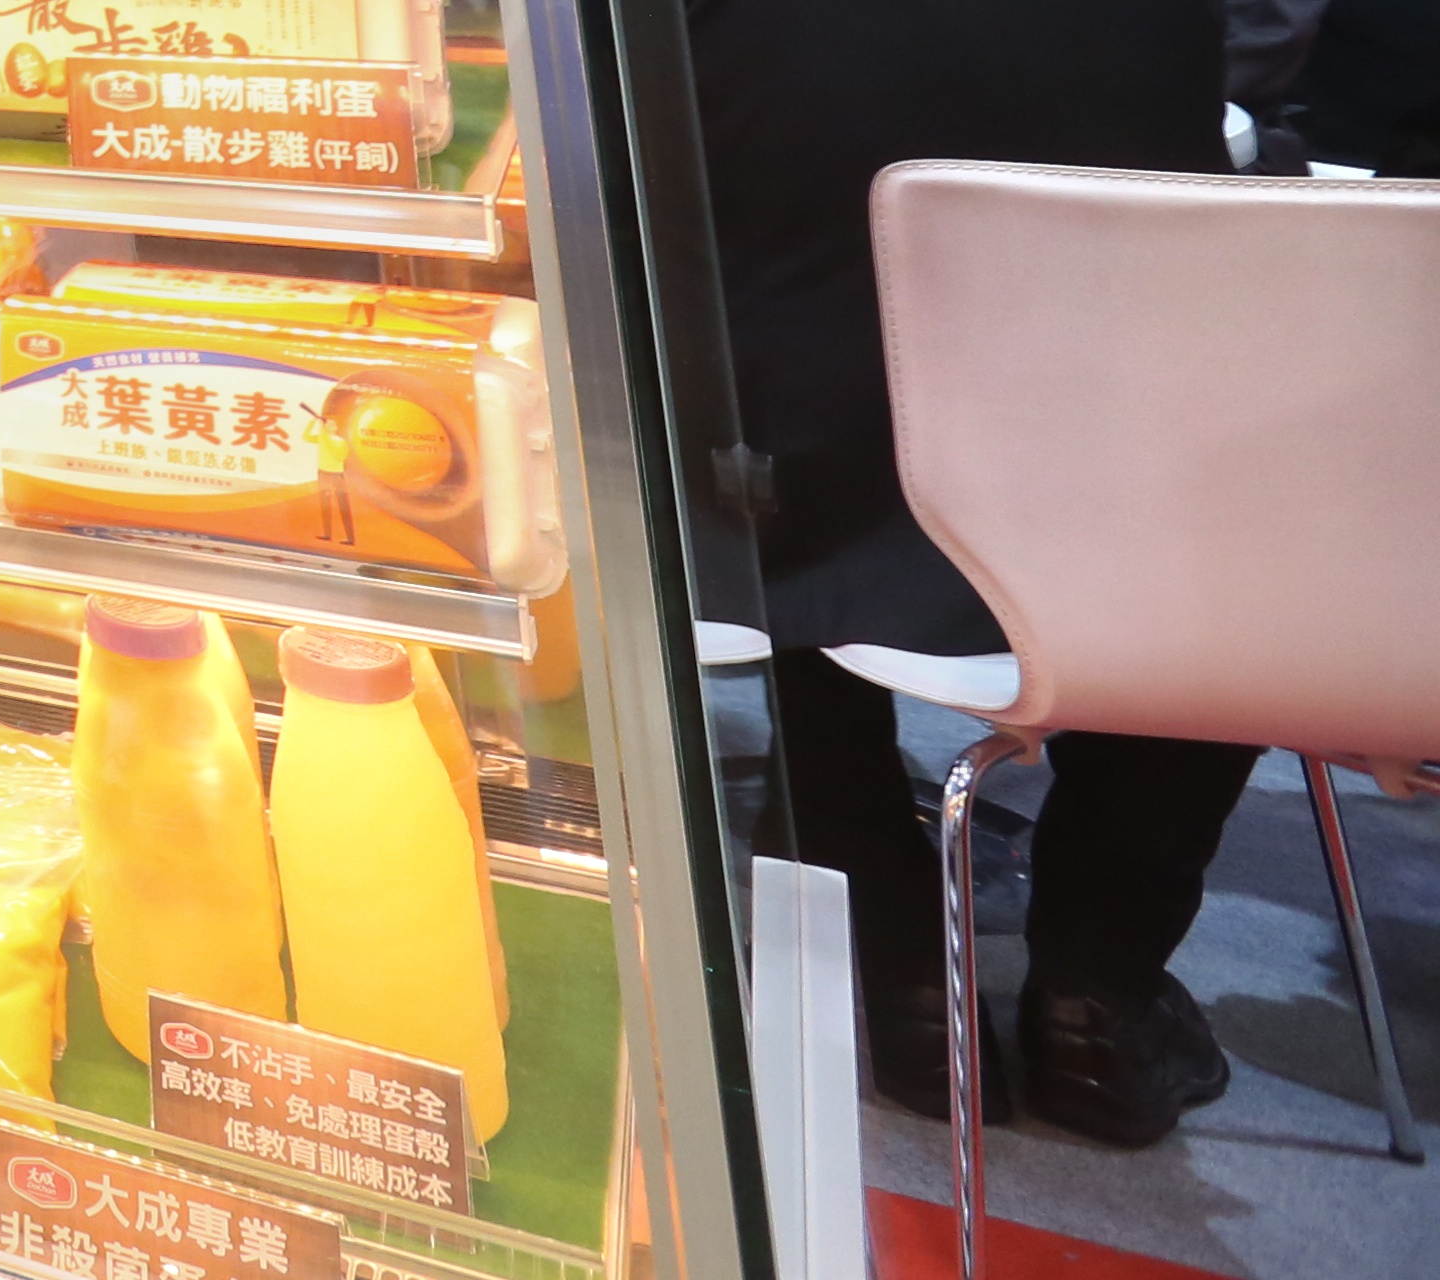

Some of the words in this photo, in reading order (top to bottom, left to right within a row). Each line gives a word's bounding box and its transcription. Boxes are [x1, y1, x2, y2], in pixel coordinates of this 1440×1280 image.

[162, 72, 379, 120] 動物福利蛋
[91, 121, 400, 174] 大成-散步雞(平飼)
[60, 370, 90, 430] 大成
[96, 373, 292, 453] 葉黃素
[160, 1059, 454, 1171] 高效率、免處理蛋殼
[219, 1032, 449, 1128] 不沾手、最安全
[223, 1115, 456, 1209] 低教育訓練成本
[0, 1210, 238, 1280] 非殺菌
[83, 1173, 290, 1275] 大成專業
